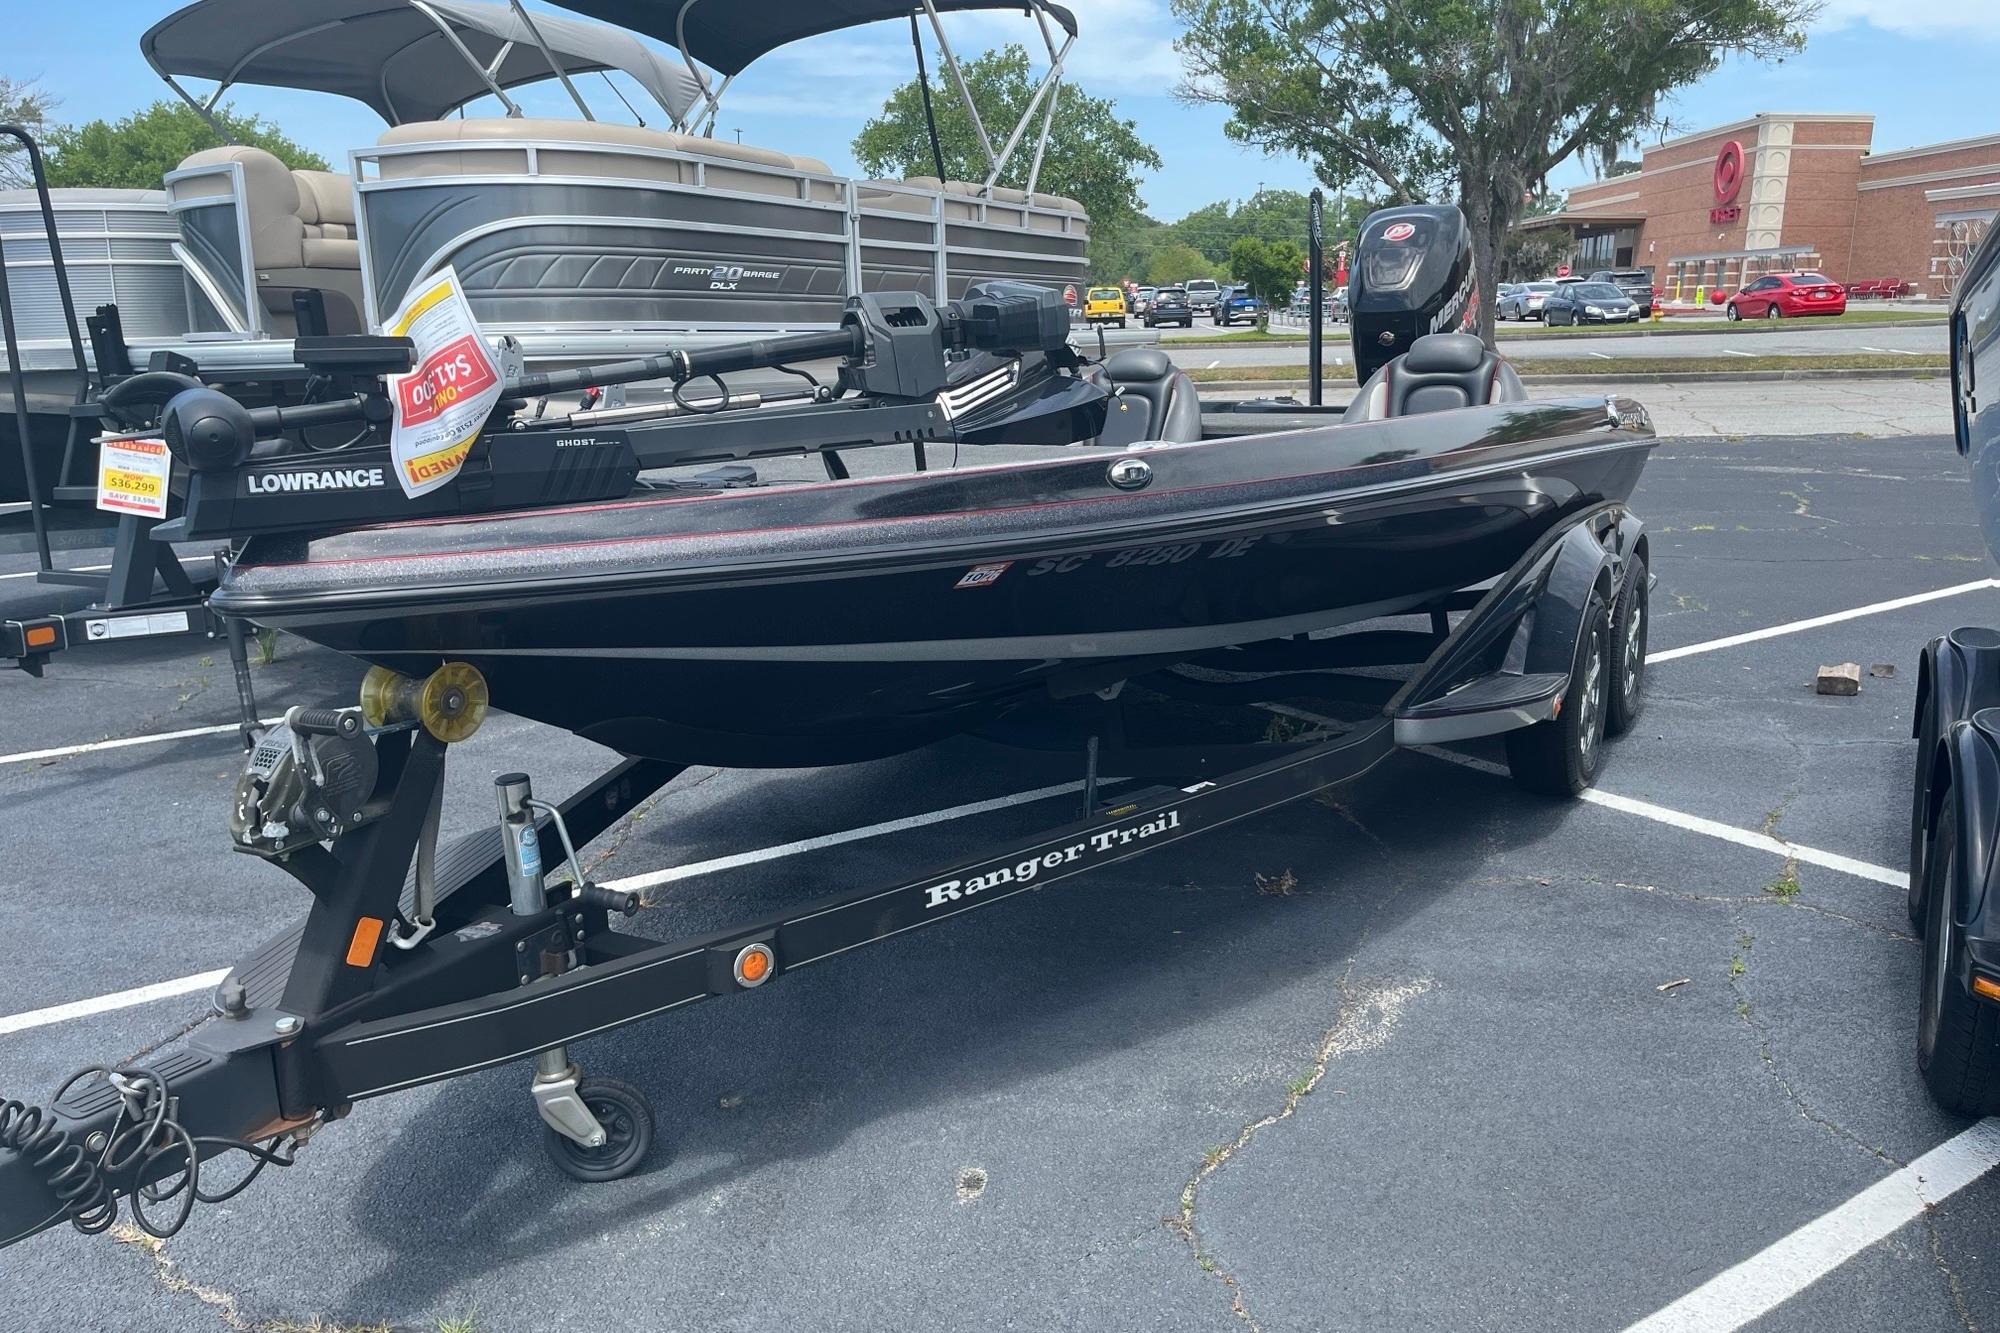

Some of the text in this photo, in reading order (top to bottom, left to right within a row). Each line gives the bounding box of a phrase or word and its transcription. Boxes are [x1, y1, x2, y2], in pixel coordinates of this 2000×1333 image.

[673, 265, 780, 281] PARTY 20 BARGE
[709, 281, 738, 290] DLX
[412, 353, 473, 406] $41,500
[432, 385, 458, 414] ONLY
[556, 438, 596, 447] GHOST
[406, 451, 467, 483] WNED!
[248, 468, 384, 495] LOWRANCE
[1026, 552, 1092, 577] SC
[924, 810, 1181, 909] Ranger Trail
